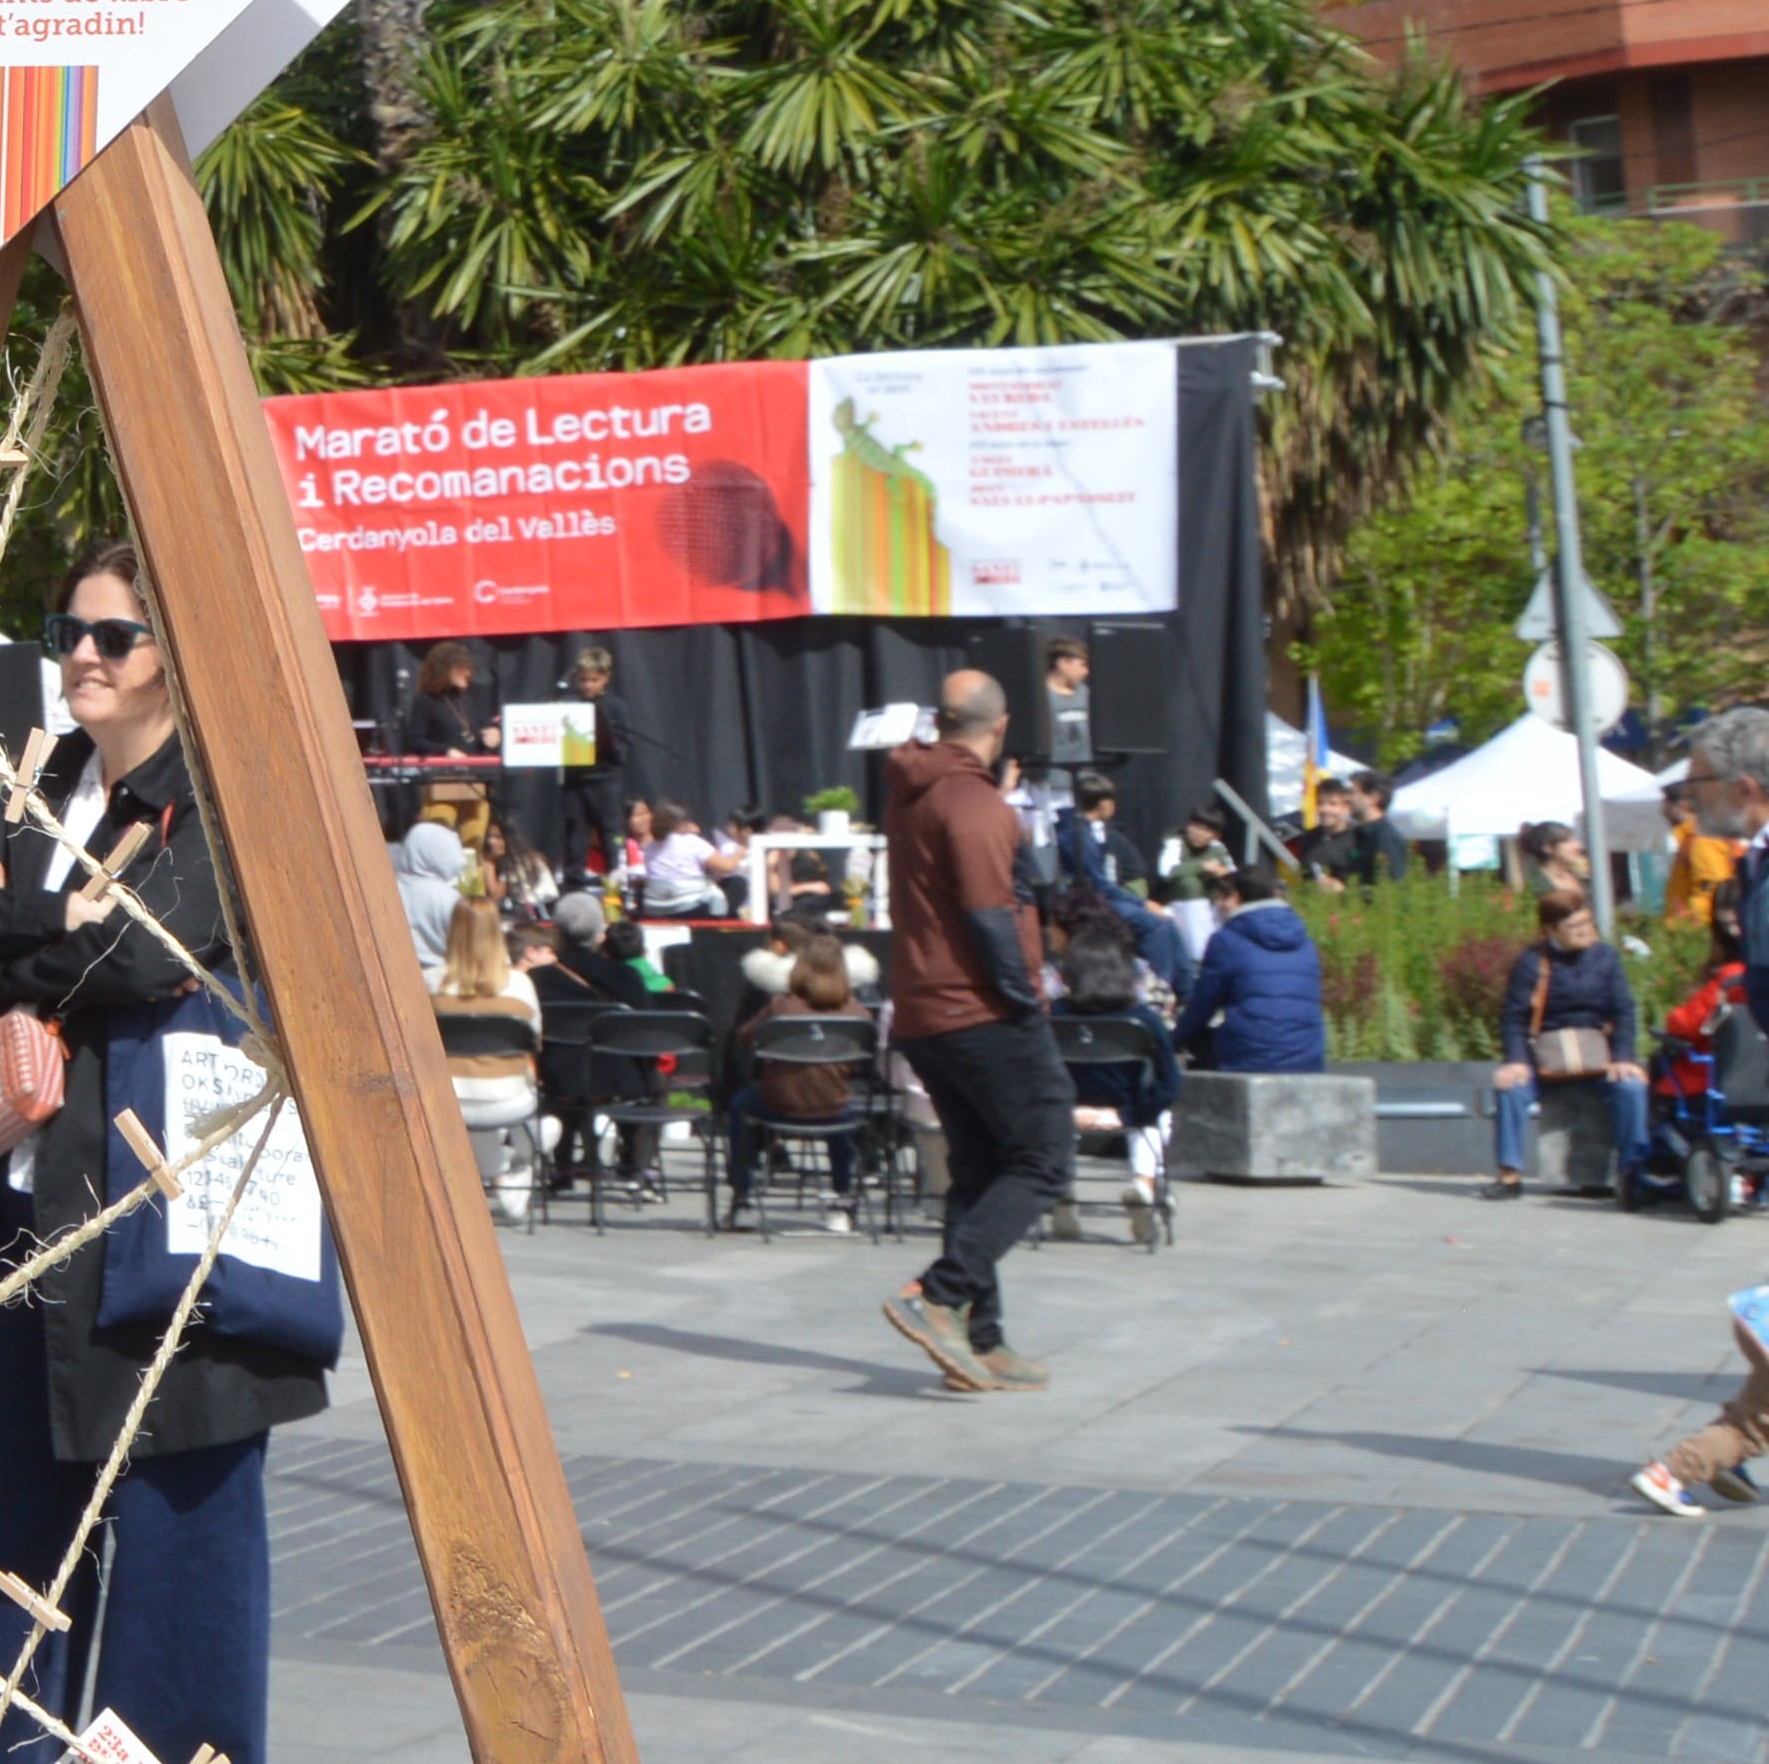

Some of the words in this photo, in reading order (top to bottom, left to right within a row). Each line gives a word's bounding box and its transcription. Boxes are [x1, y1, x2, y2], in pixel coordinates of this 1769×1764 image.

[295, 409, 450, 460] Marató
[461, 409, 516, 449] de
[526, 403, 711, 445] Lectura
[298, 473, 324, 508] i
[333, 454, 690, 505] Recomanacions
[296, 521, 457, 554] Cerdanyola
[464, 516, 513, 543] del
[518, 509, 615, 539] Vallès
[98, 1725, 128, 1762] 23a
